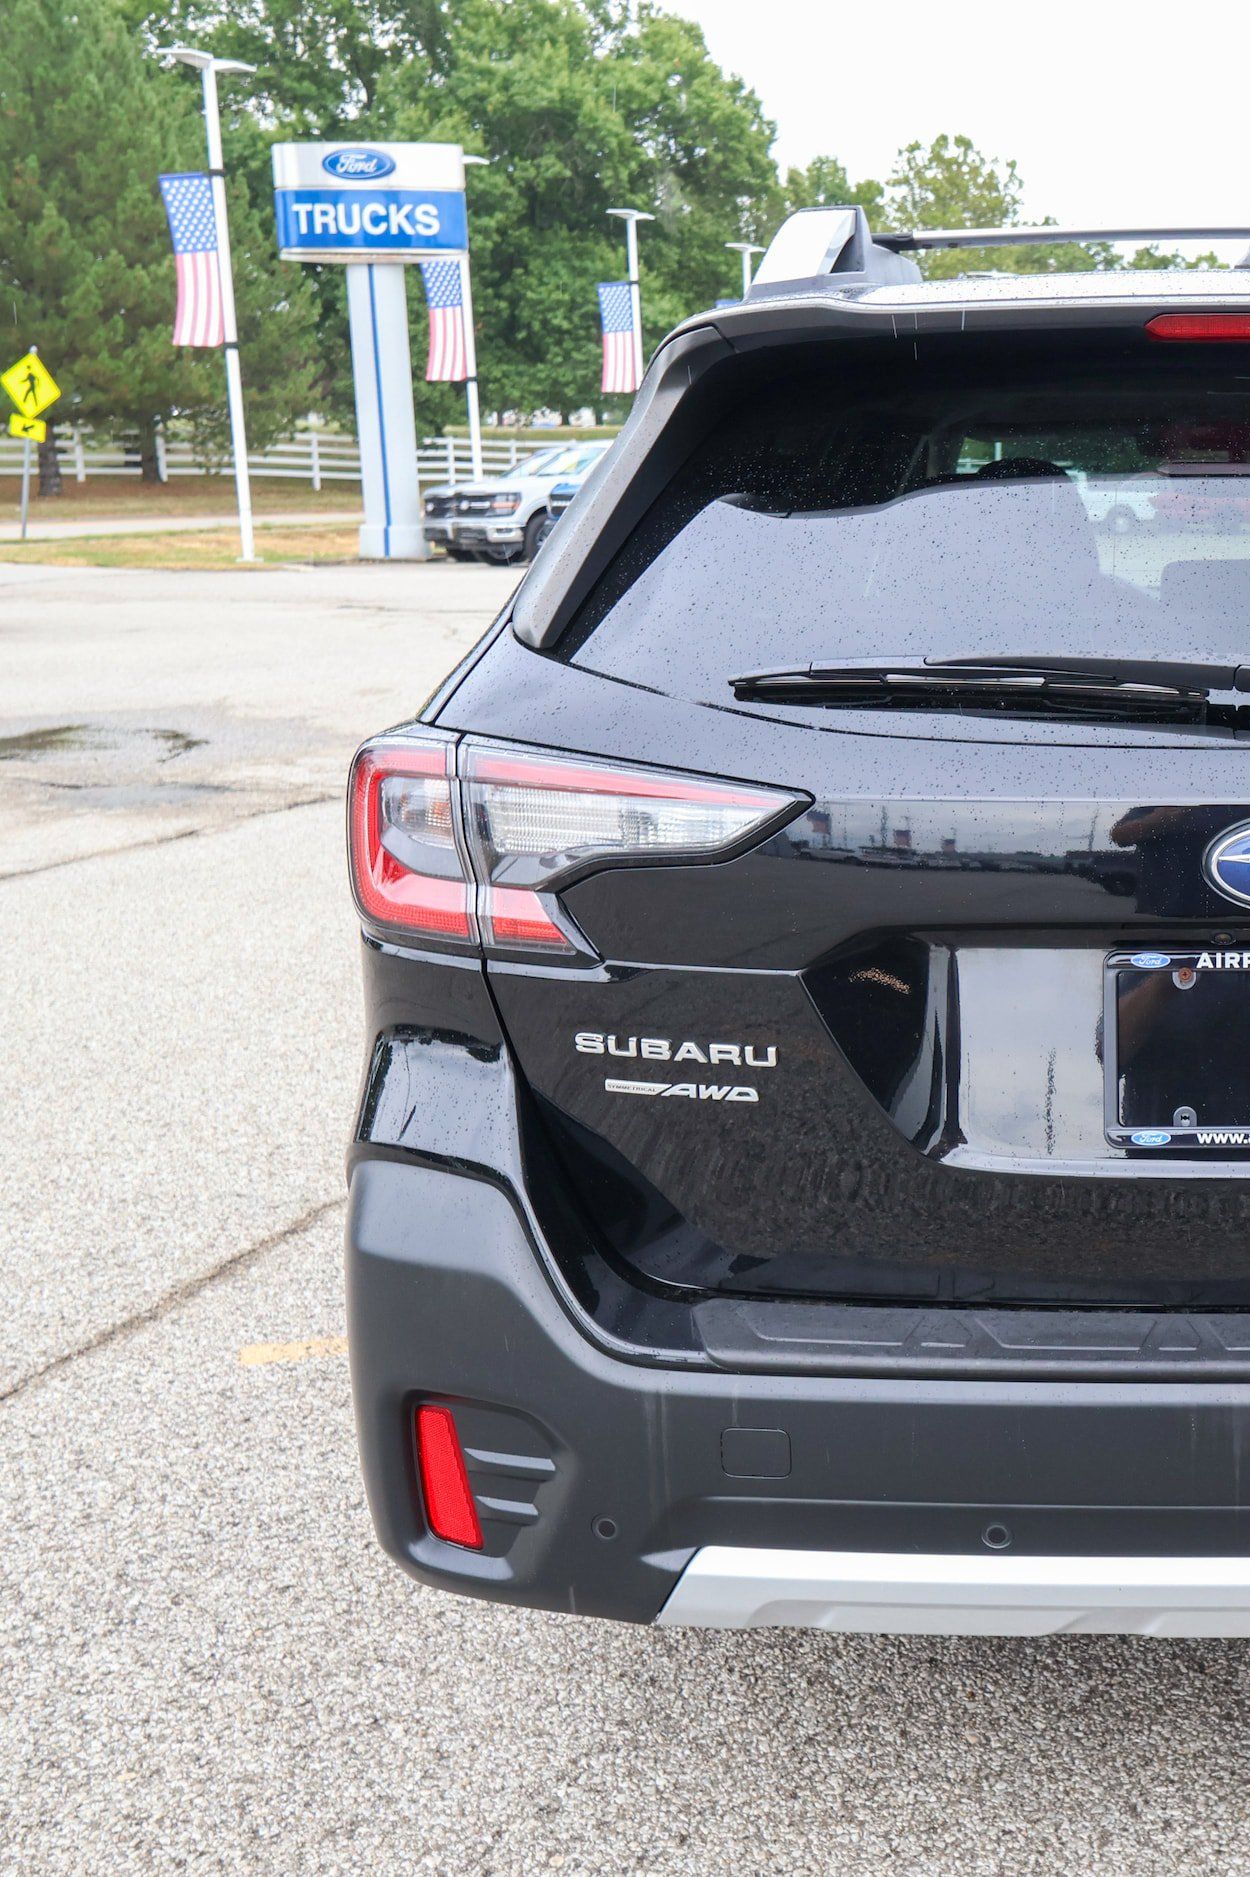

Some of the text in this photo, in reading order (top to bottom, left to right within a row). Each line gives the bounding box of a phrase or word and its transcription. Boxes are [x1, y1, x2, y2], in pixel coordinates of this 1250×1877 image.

[335, 153, 379, 174] Ford
[291, 202, 441, 237] TRUCKS
[574, 1032, 779, 1067] SUBARU
[661, 1083, 760, 1102] AWD
